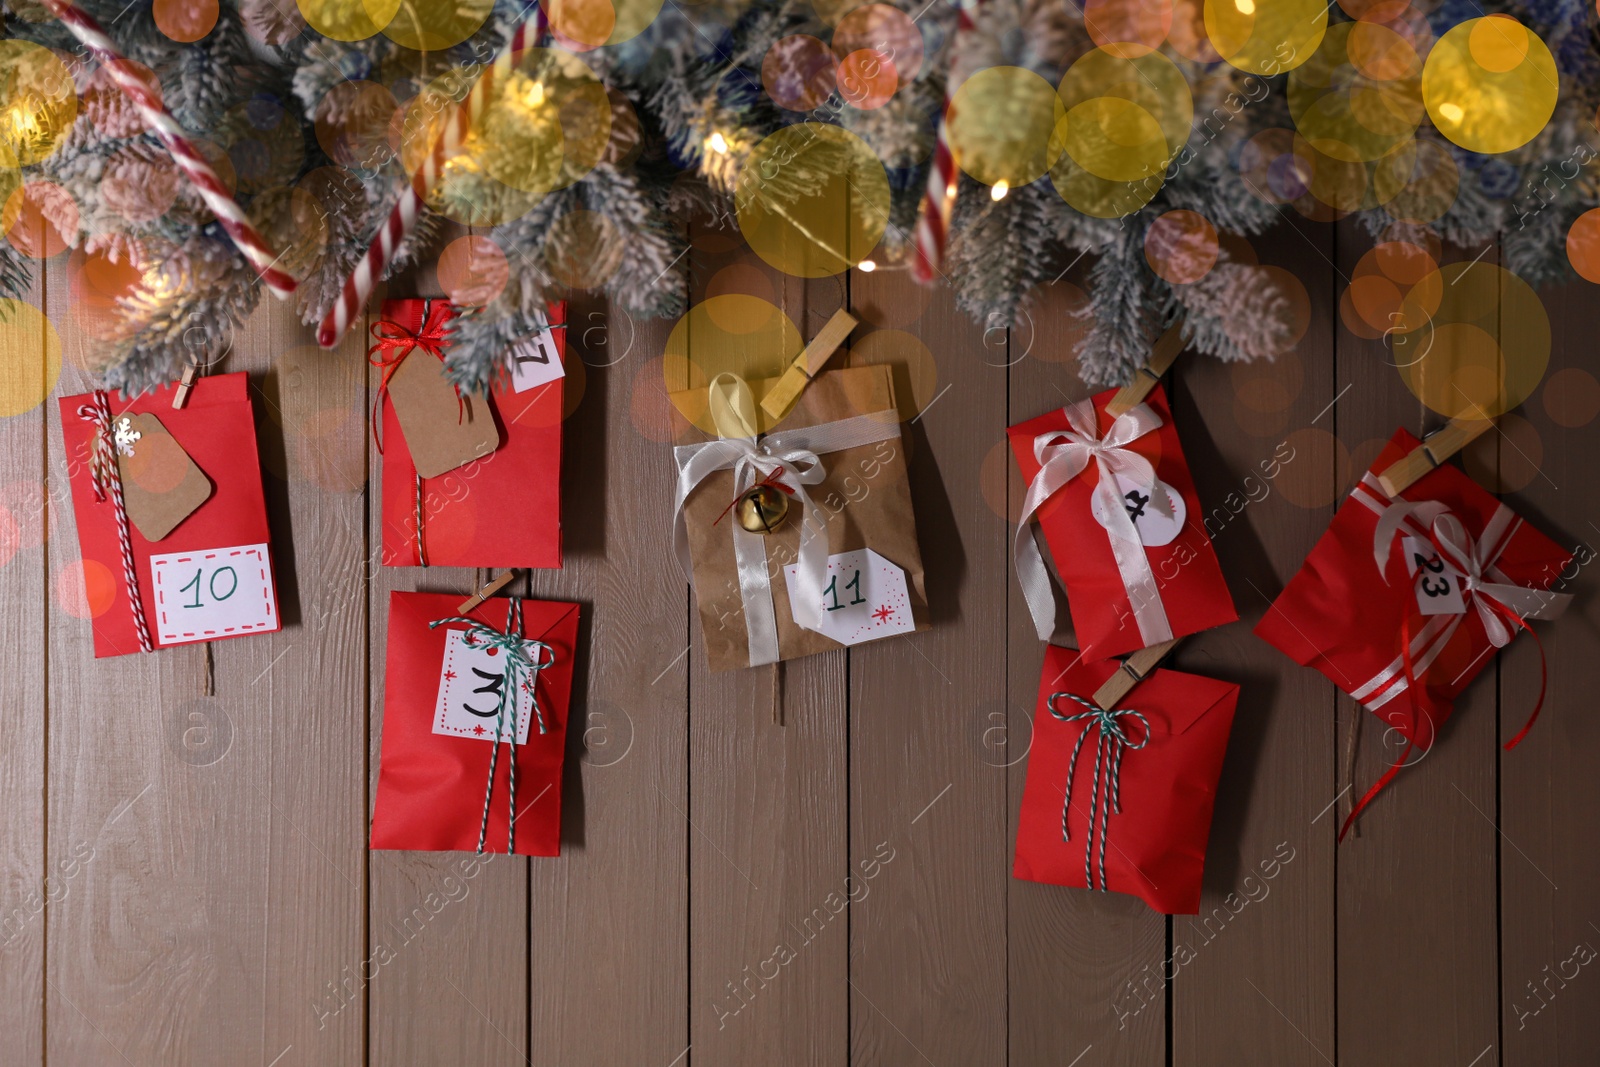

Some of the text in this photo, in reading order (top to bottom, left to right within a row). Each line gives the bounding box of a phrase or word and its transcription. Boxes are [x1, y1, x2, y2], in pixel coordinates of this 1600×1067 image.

[179, 567, 238, 608] 10
[823, 569, 867, 612] 11
[1413, 552, 1451, 598] 23
[463, 666, 507, 718] 3
